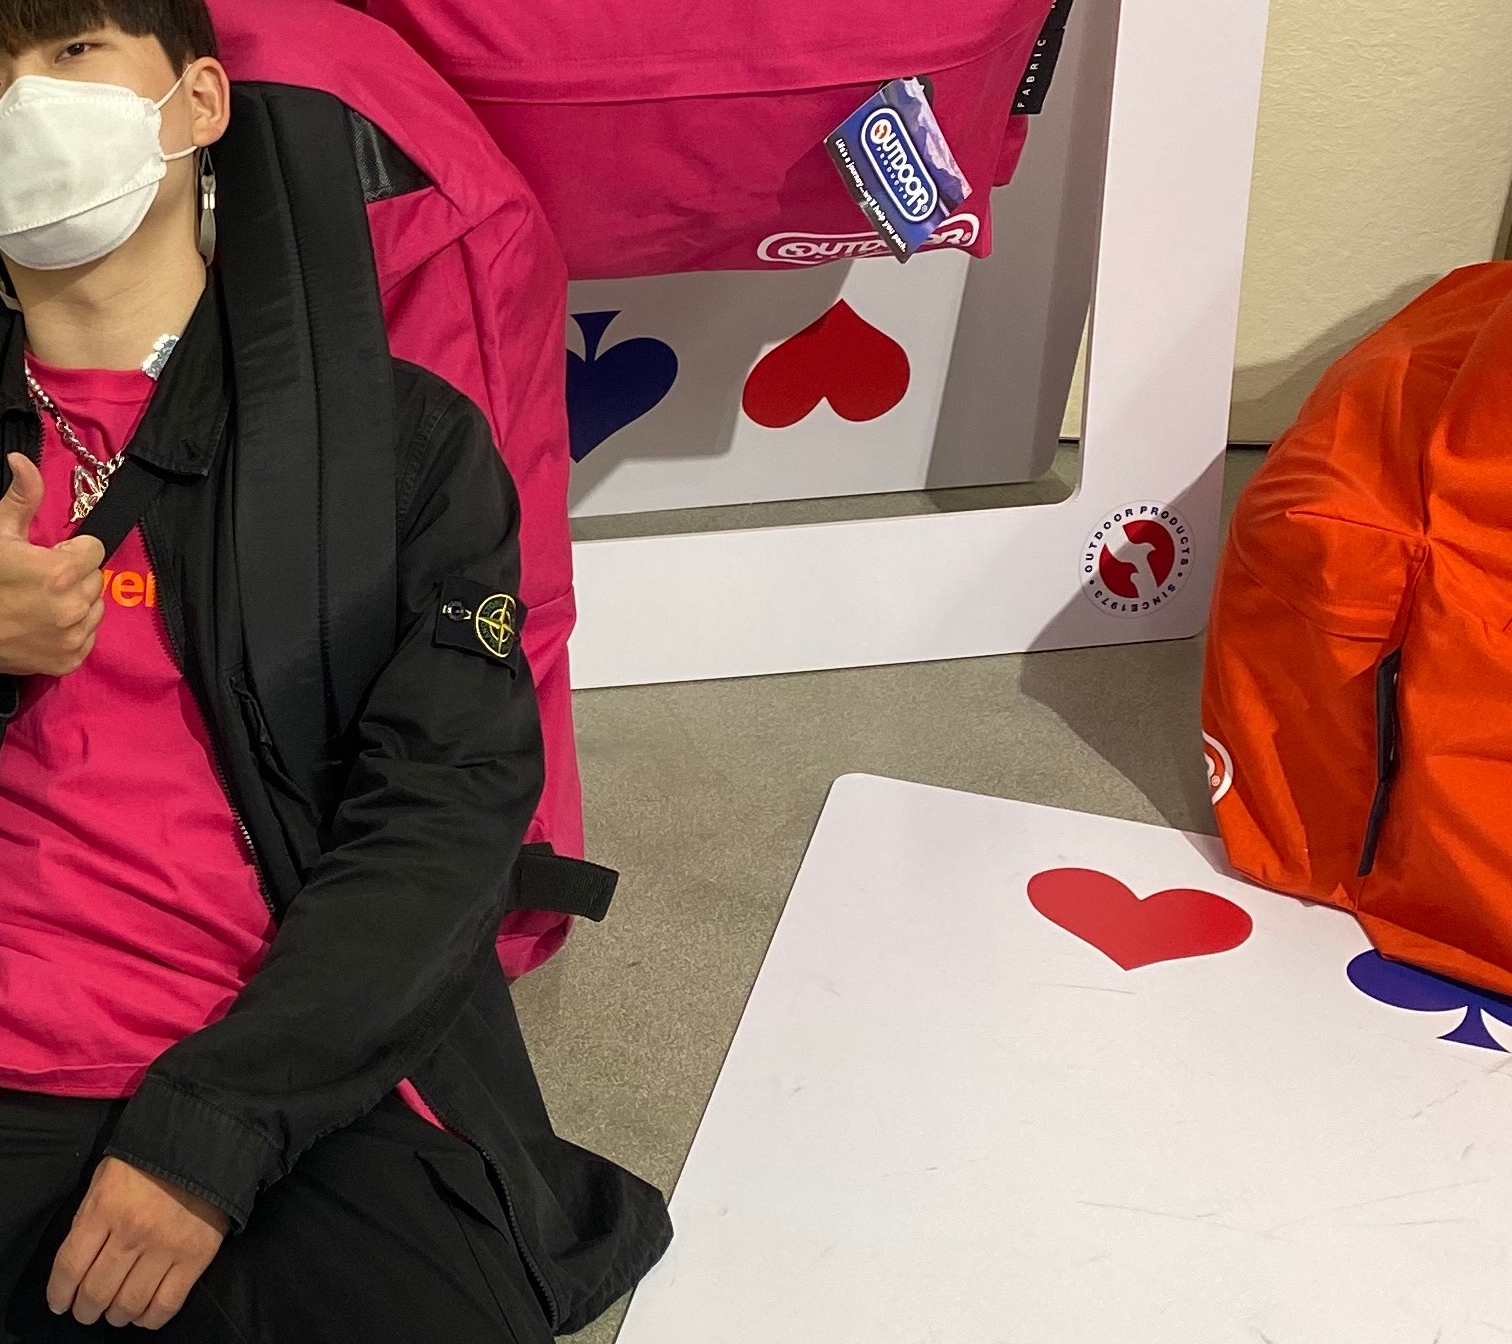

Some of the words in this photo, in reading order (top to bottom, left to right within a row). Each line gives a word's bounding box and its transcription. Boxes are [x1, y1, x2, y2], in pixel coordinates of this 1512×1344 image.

[870, 118, 930, 216] OUTDOOR
[1084, 508, 1134, 573] OUTDOOR
[1139, 506, 1191, 565] PRODUCTS
